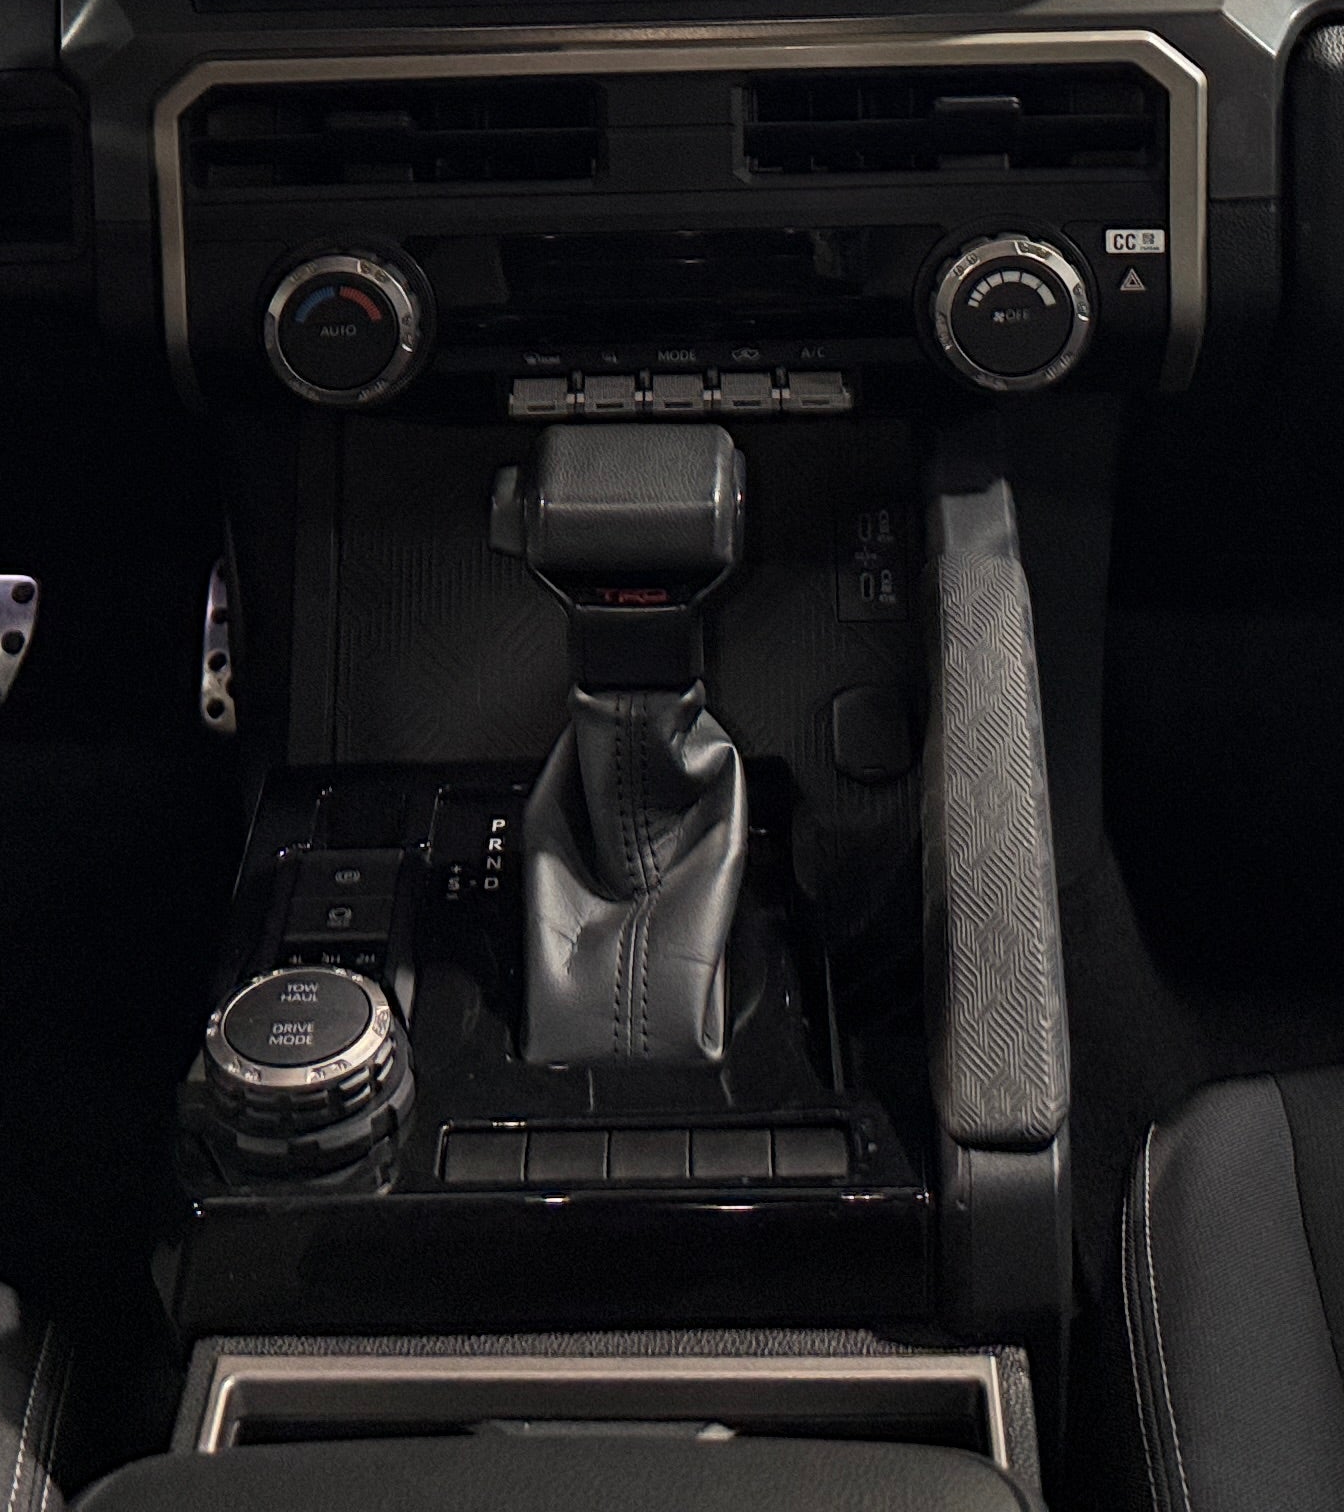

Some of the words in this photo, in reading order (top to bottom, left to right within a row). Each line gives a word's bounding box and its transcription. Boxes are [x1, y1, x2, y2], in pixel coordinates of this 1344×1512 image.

[1113, 233, 1136, 251] CC
[319, 324, 357, 337] AUTO
[657, 349, 696, 361] MODE
[801, 346, 825, 359] A/C
[491, 818, 506, 833] P
[488, 837, 503, 851] R
[486, 855, 502, 870] N
[484, 876, 499, 890] D
[287, 982, 318, 993] TOW
[280, 991, 318, 1003] HAUL
[272, 1021, 314, 1035] DRIVE
[268, 1033, 314, 1045] MODE
